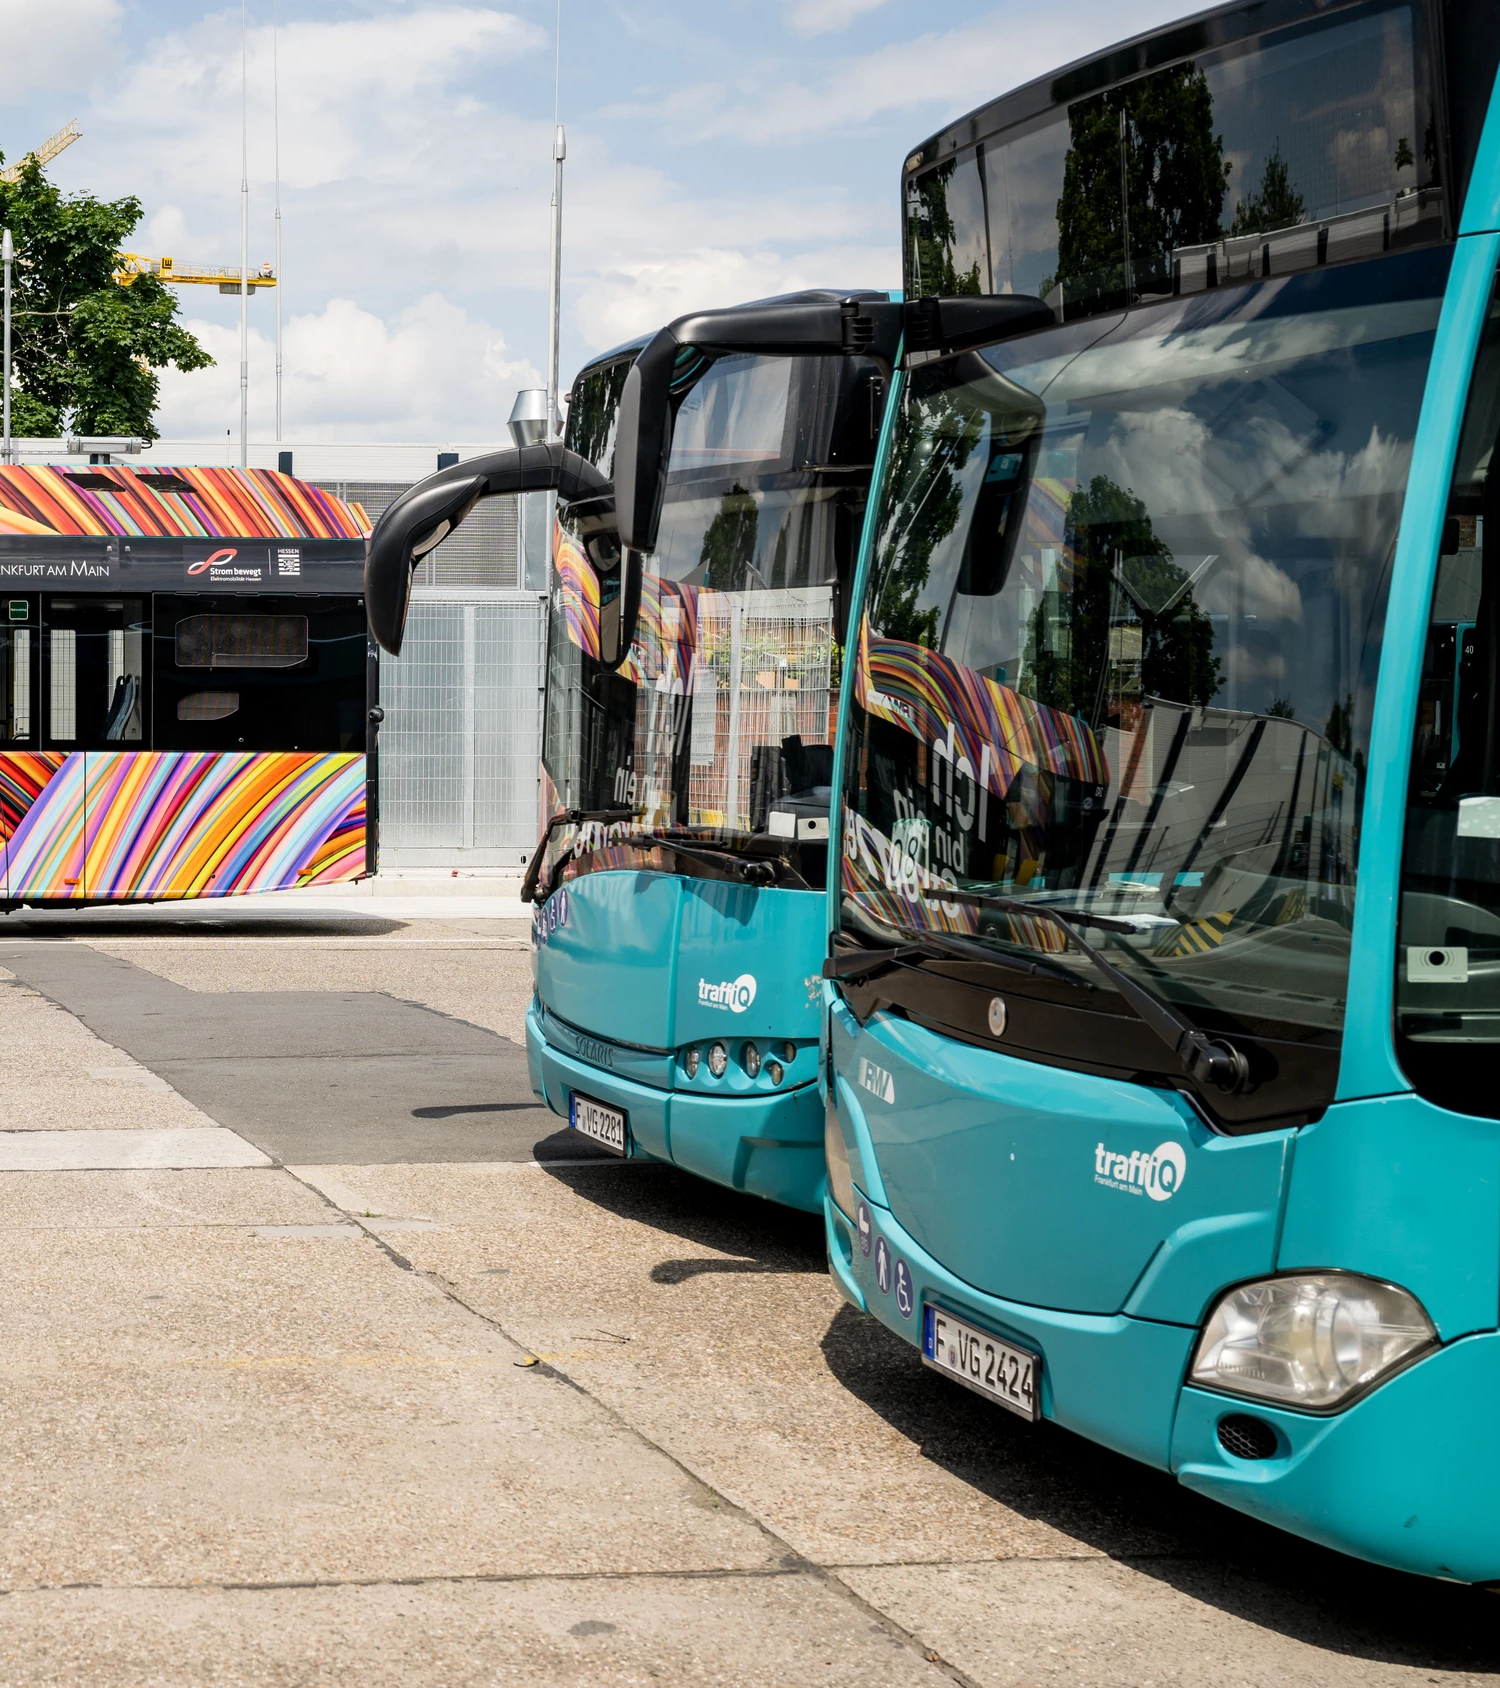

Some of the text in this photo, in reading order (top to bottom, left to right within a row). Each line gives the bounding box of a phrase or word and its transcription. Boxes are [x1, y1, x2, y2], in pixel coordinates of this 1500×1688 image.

[210, 567, 262, 577] Strom bewegt
[698, 974, 756, 1012] traffiQ
[575, 1035, 613, 1068] SOLARIS
[576, 1101, 622, 1146] F VG 2281
[1095, 1142, 1185, 1199] traffiQ
[936, 1318, 946, 1357] F
[958, 1330, 981, 1380] VG
[985, 1343, 1033, 1405] 2424
